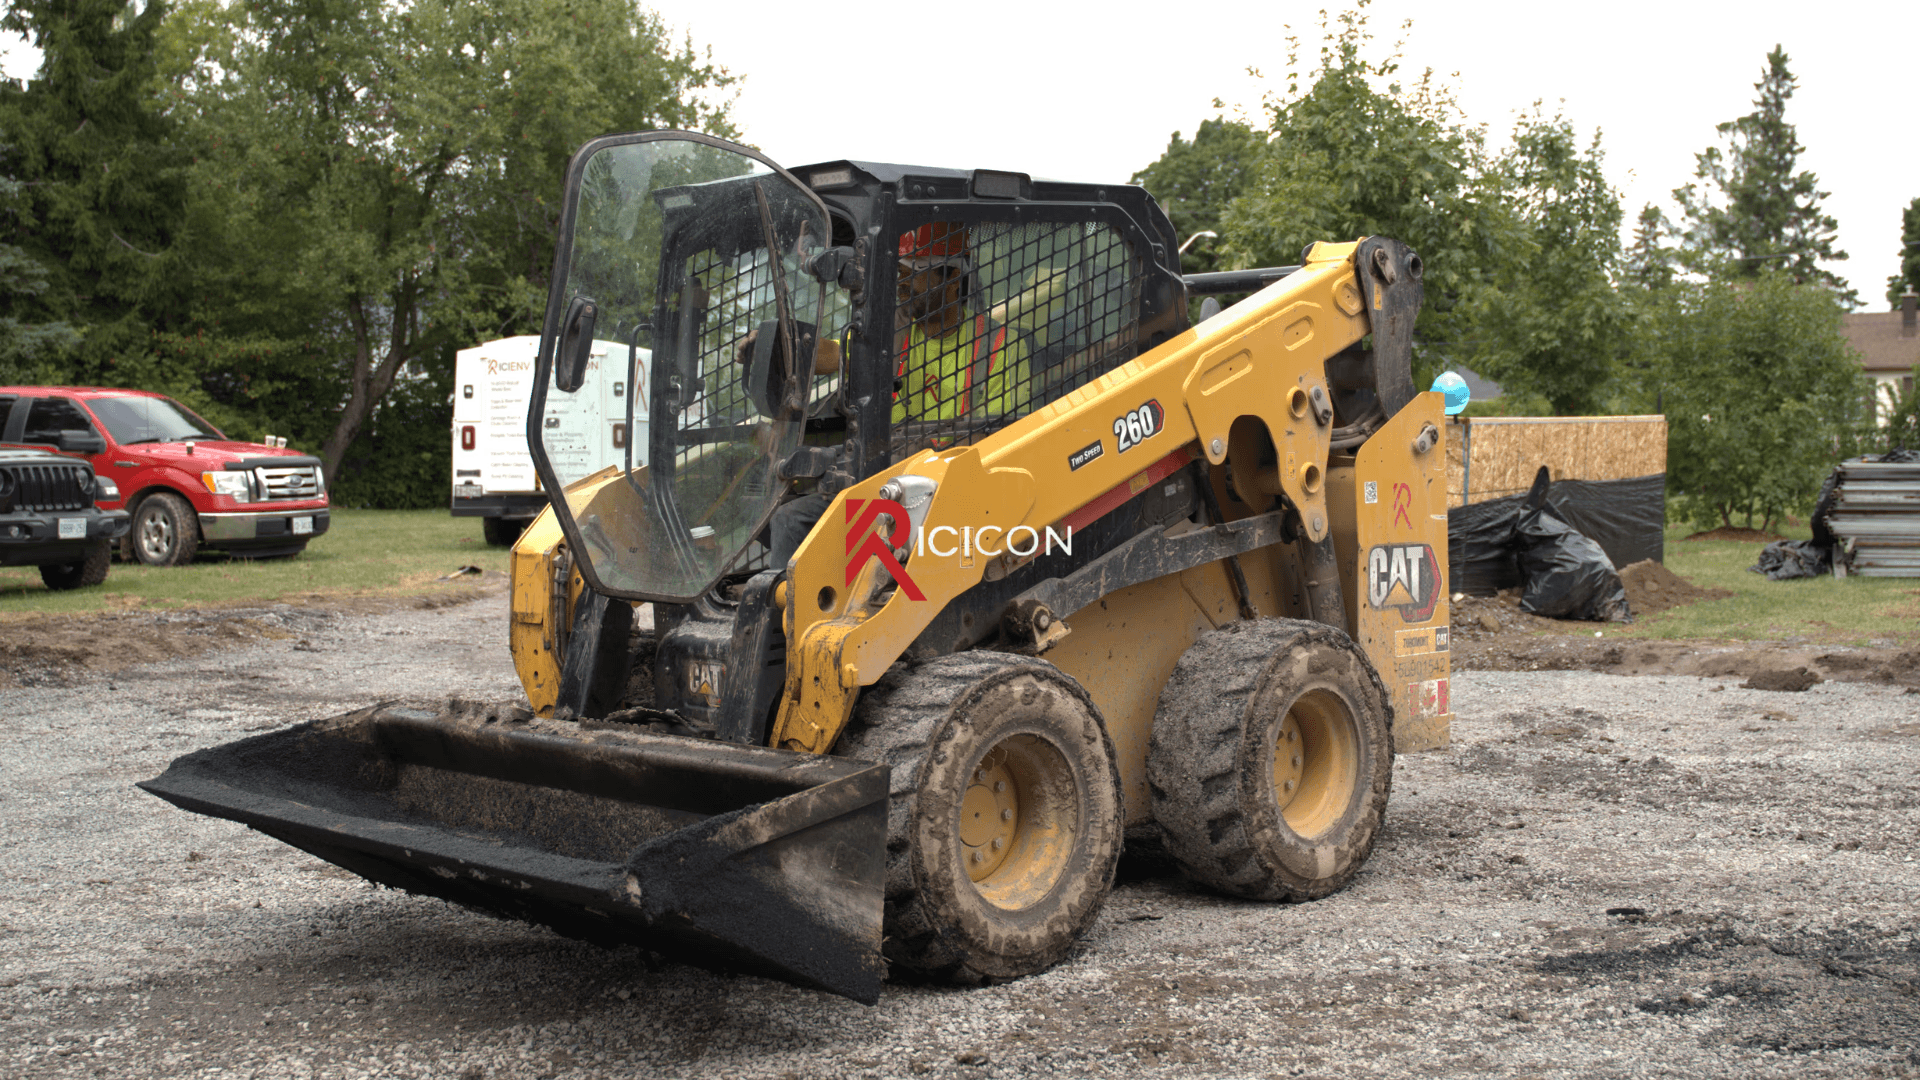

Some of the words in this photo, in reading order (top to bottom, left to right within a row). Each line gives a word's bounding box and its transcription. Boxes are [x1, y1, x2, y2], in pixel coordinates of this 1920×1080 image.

[1114, 404, 1155, 452] 260
[1369, 546, 1424, 607] CAT
[1436, 632, 1447, 646] CAT
[689, 662, 721, 697] CAT
